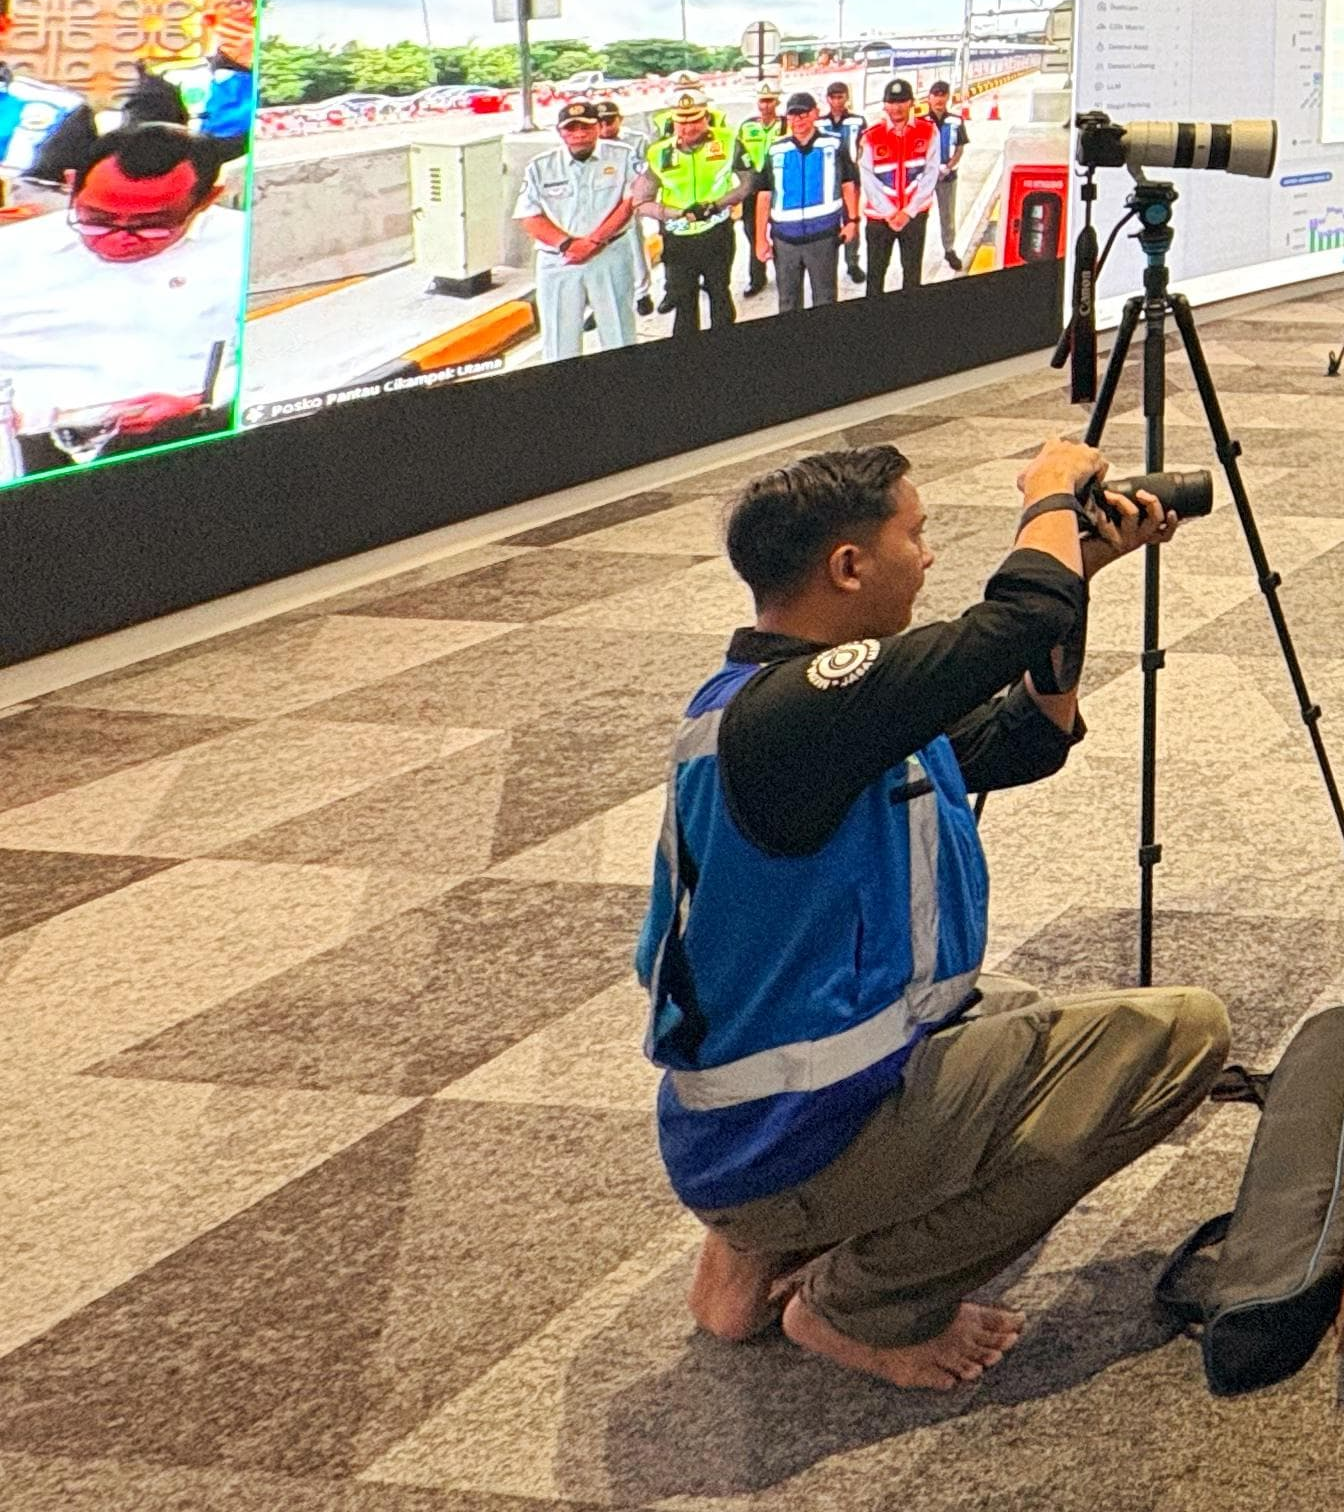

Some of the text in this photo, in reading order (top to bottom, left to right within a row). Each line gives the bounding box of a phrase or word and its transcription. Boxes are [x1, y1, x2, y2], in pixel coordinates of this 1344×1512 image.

[1080, 270, 1091, 317] Canon
[270, 395, 323, 418] Posko
[326, 384, 381, 406] Pantau
[383, 367, 456, 392] Cikampek
